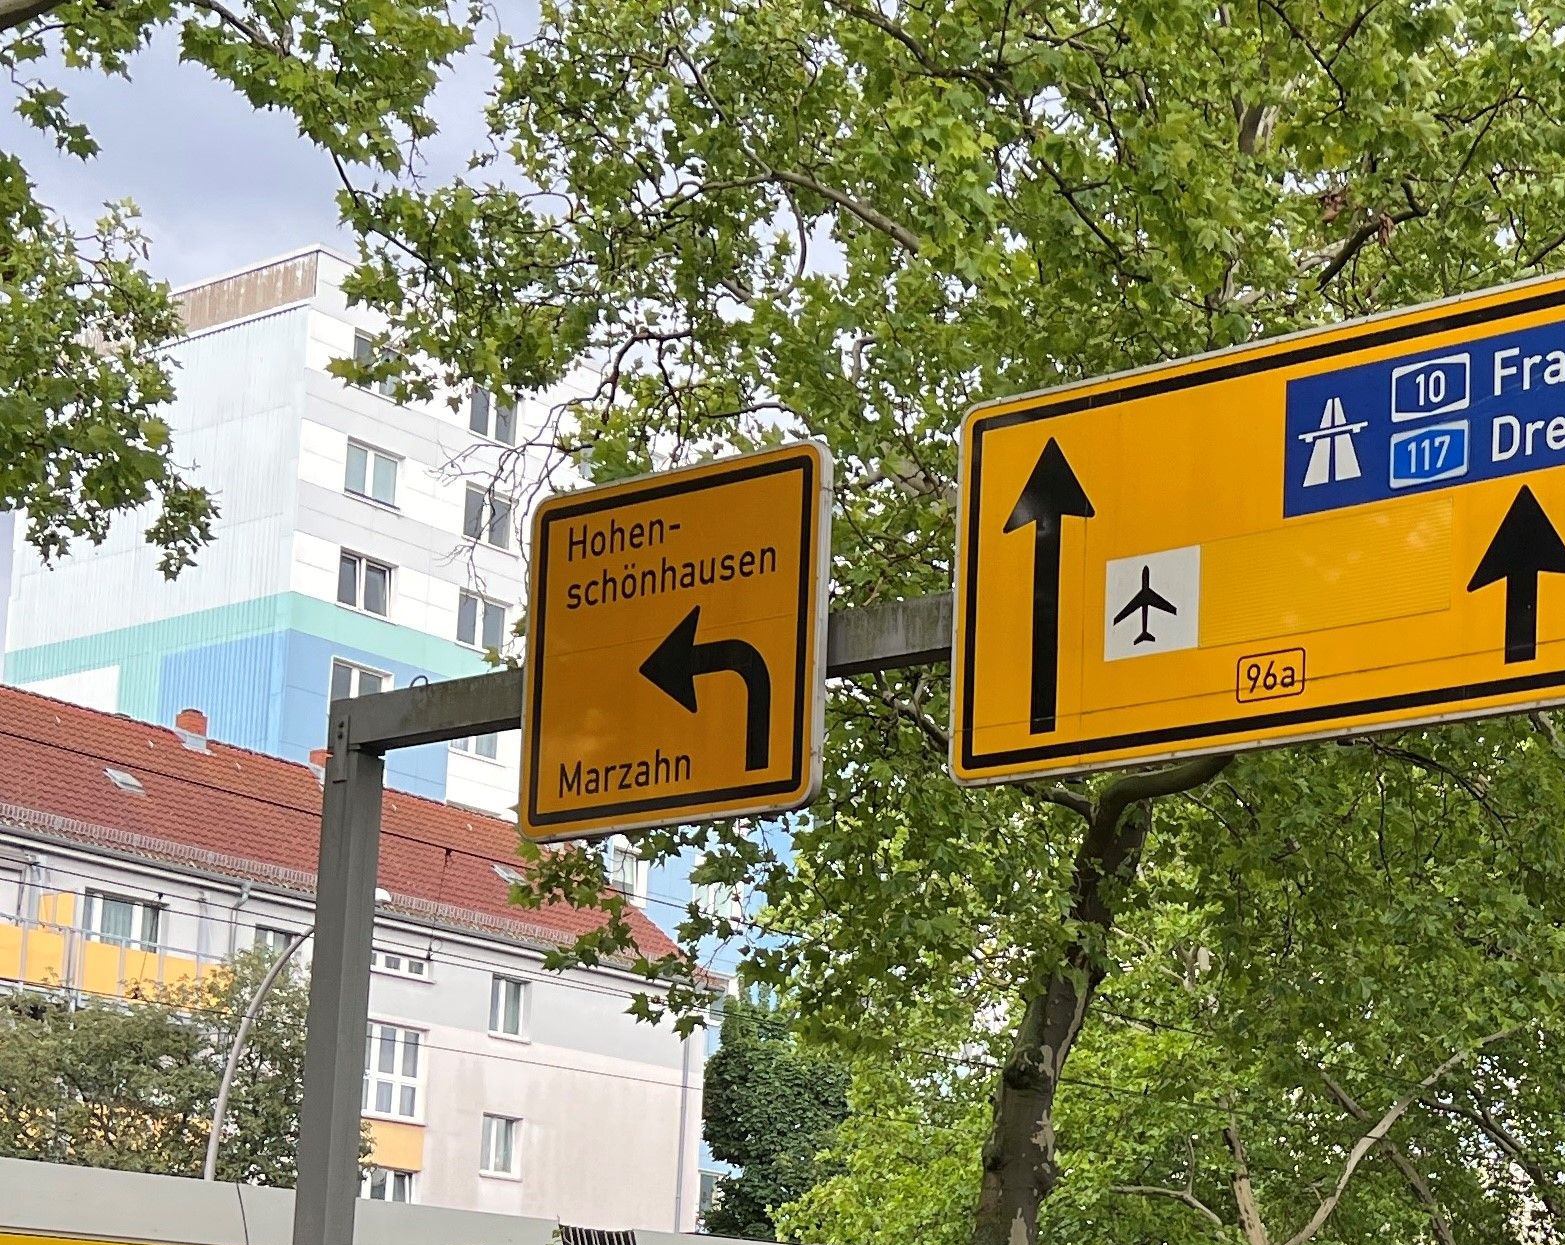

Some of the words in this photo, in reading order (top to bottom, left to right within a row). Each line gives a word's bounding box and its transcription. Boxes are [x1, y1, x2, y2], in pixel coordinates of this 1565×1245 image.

[1416, 370, 1446, 406] 10
[1408, 435, 1451, 474] 117
[568, 518, 681, 562] Hohen-
[566, 546, 776, 610] schönhausen
[1247, 661, 1295, 694] 96a
[559, 749, 691, 799] Marzahn
